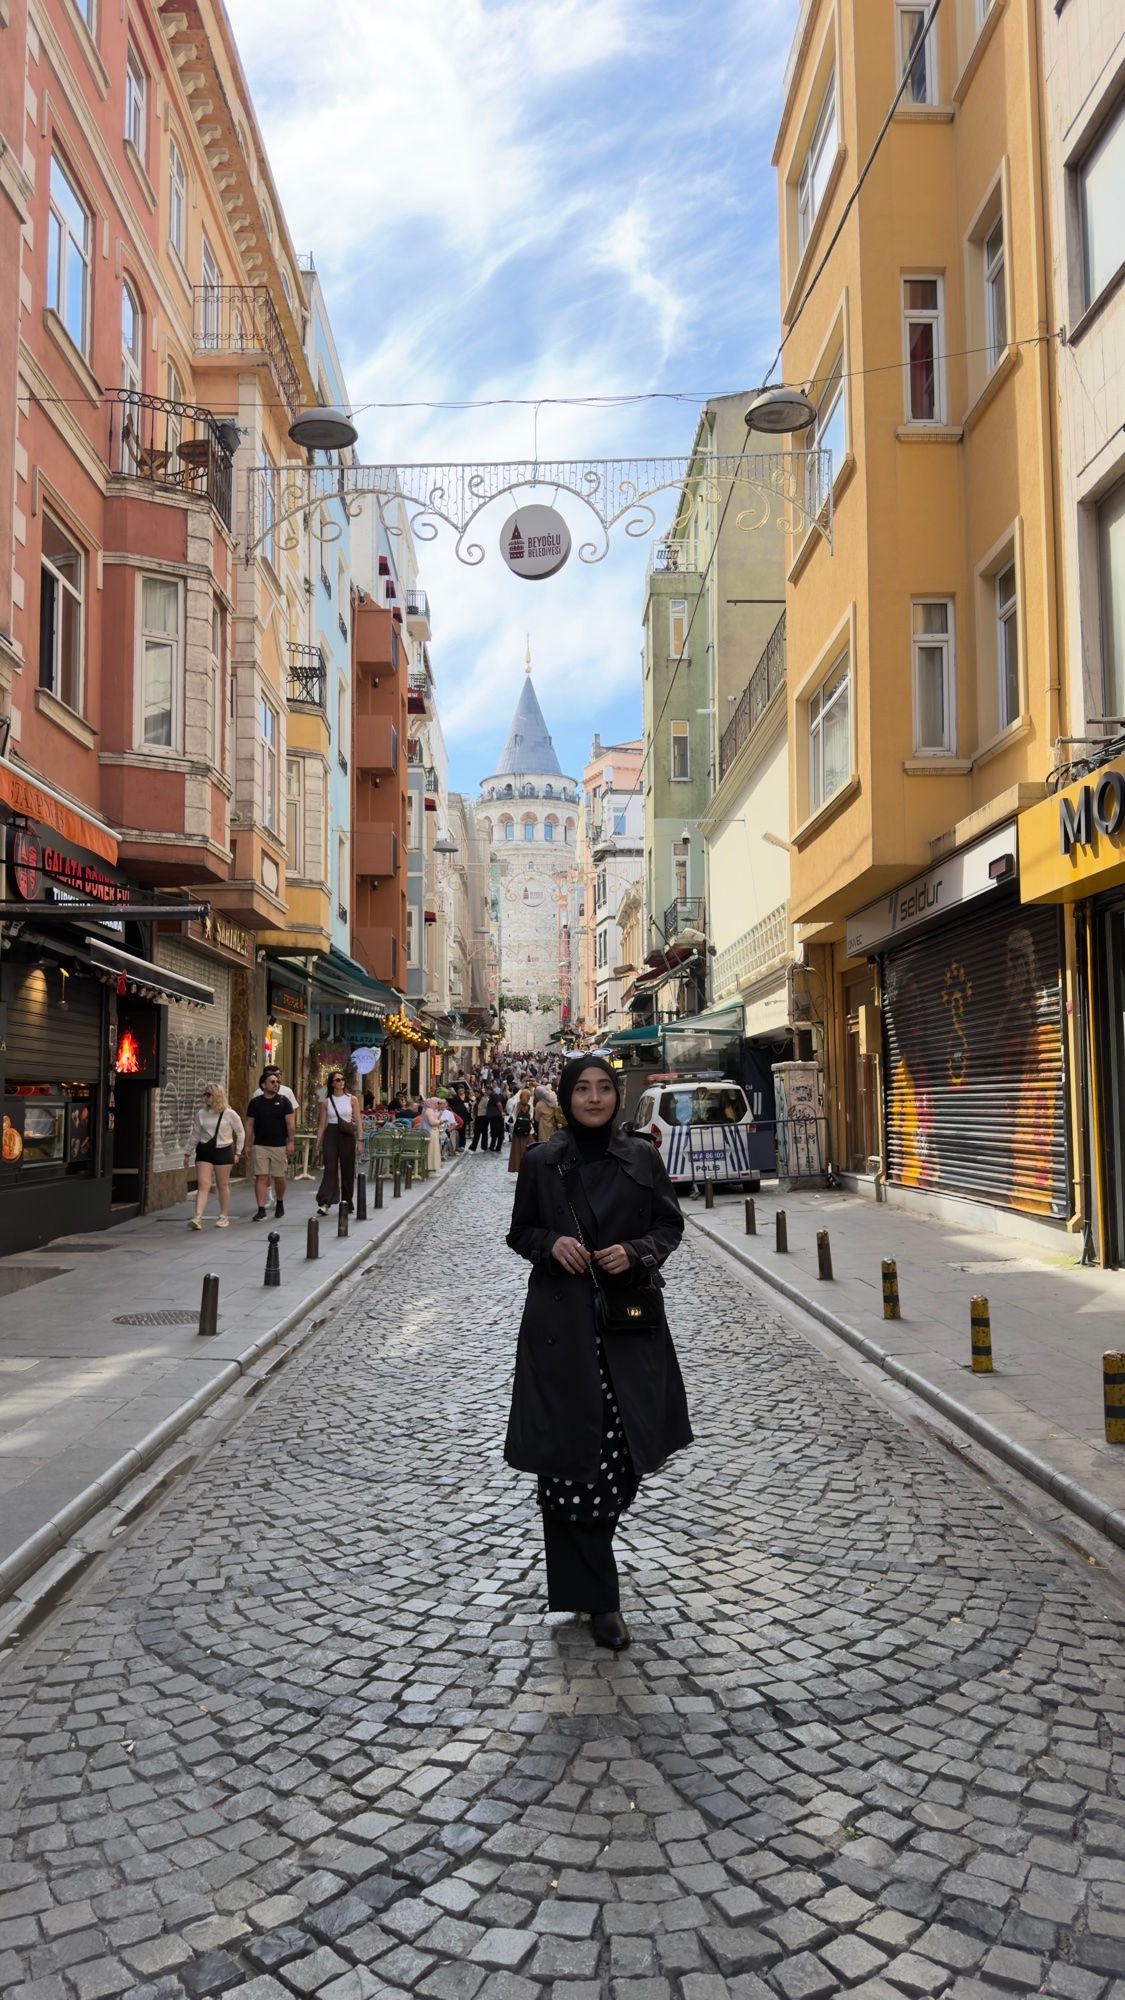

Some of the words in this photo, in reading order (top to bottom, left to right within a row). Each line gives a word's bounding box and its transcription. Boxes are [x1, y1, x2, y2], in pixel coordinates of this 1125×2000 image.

[528, 533, 561, 548] BEYOĞLU
[528, 546, 561, 558] BELEDİYESİ
[44, 846, 83, 890] GALATA
[85, 866, 115, 901] DÖNER
[900, 880, 943, 922] seldur
